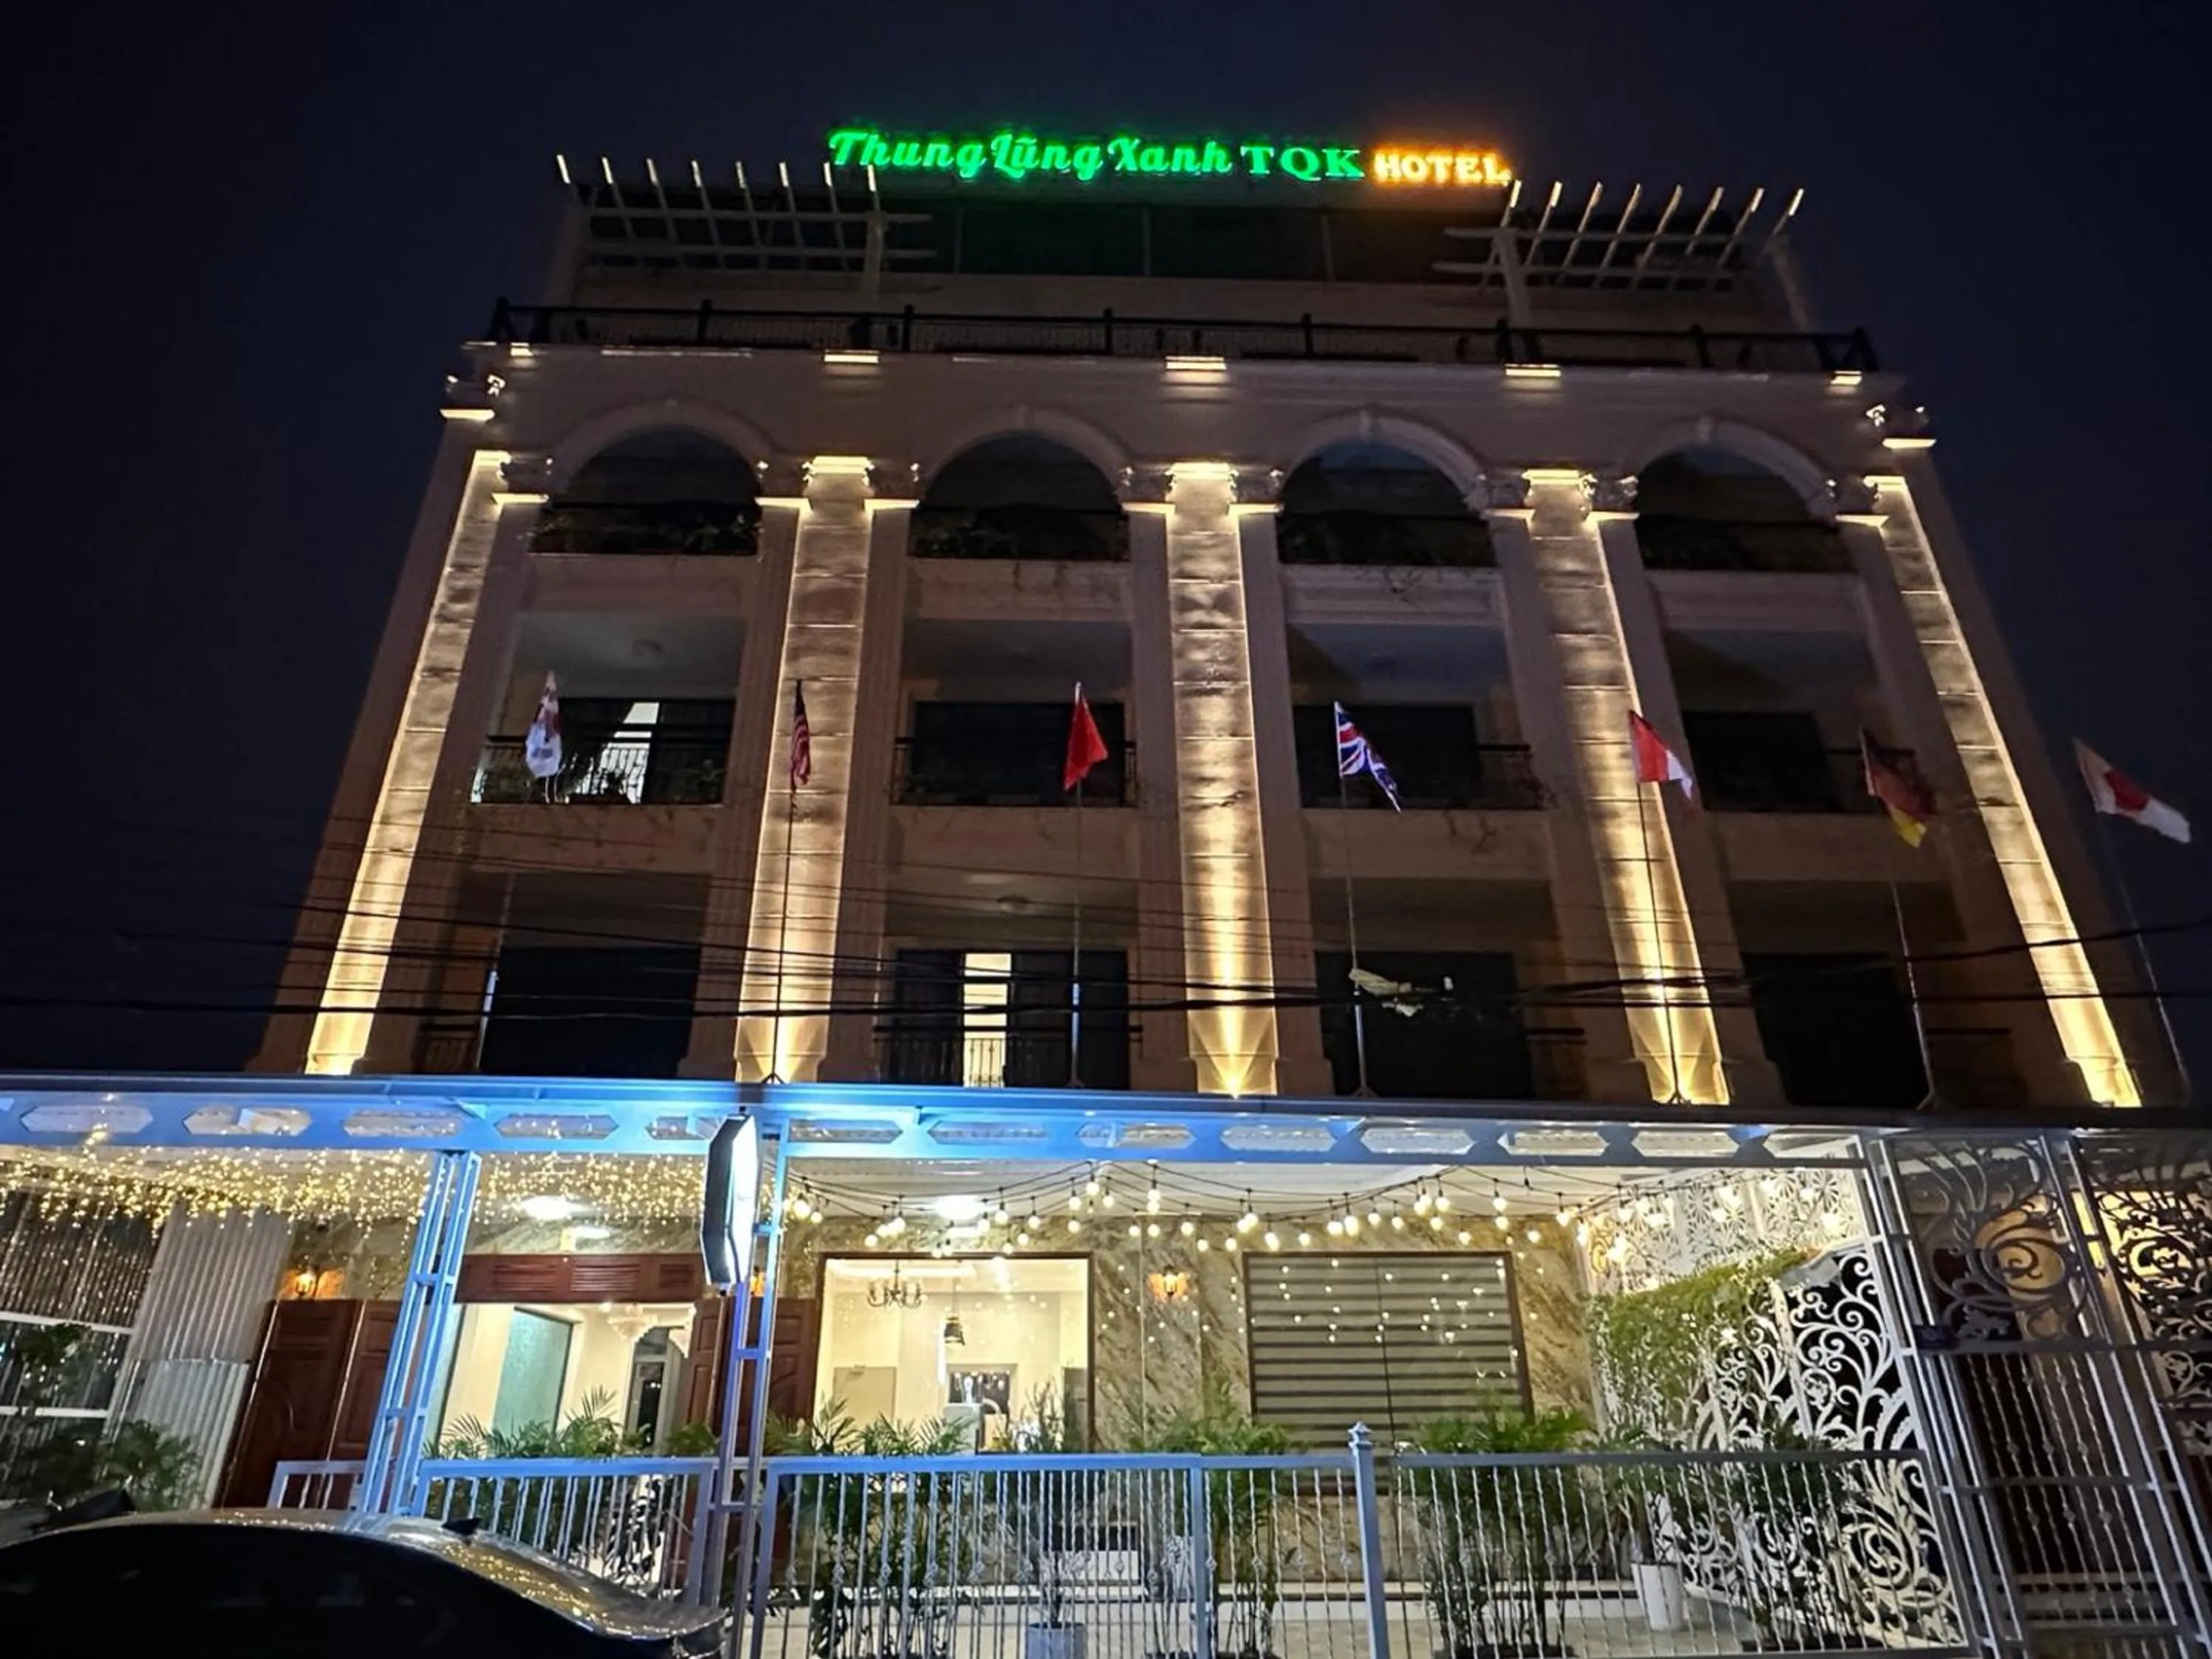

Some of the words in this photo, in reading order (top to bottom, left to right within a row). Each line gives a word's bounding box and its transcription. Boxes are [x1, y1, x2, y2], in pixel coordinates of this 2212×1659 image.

[828, 131, 987, 178] Thung
[1107, 138, 1234, 174] Xanh
[1240, 146, 1365, 181] TQK
[1373, 150, 1512, 186] HOTEL
